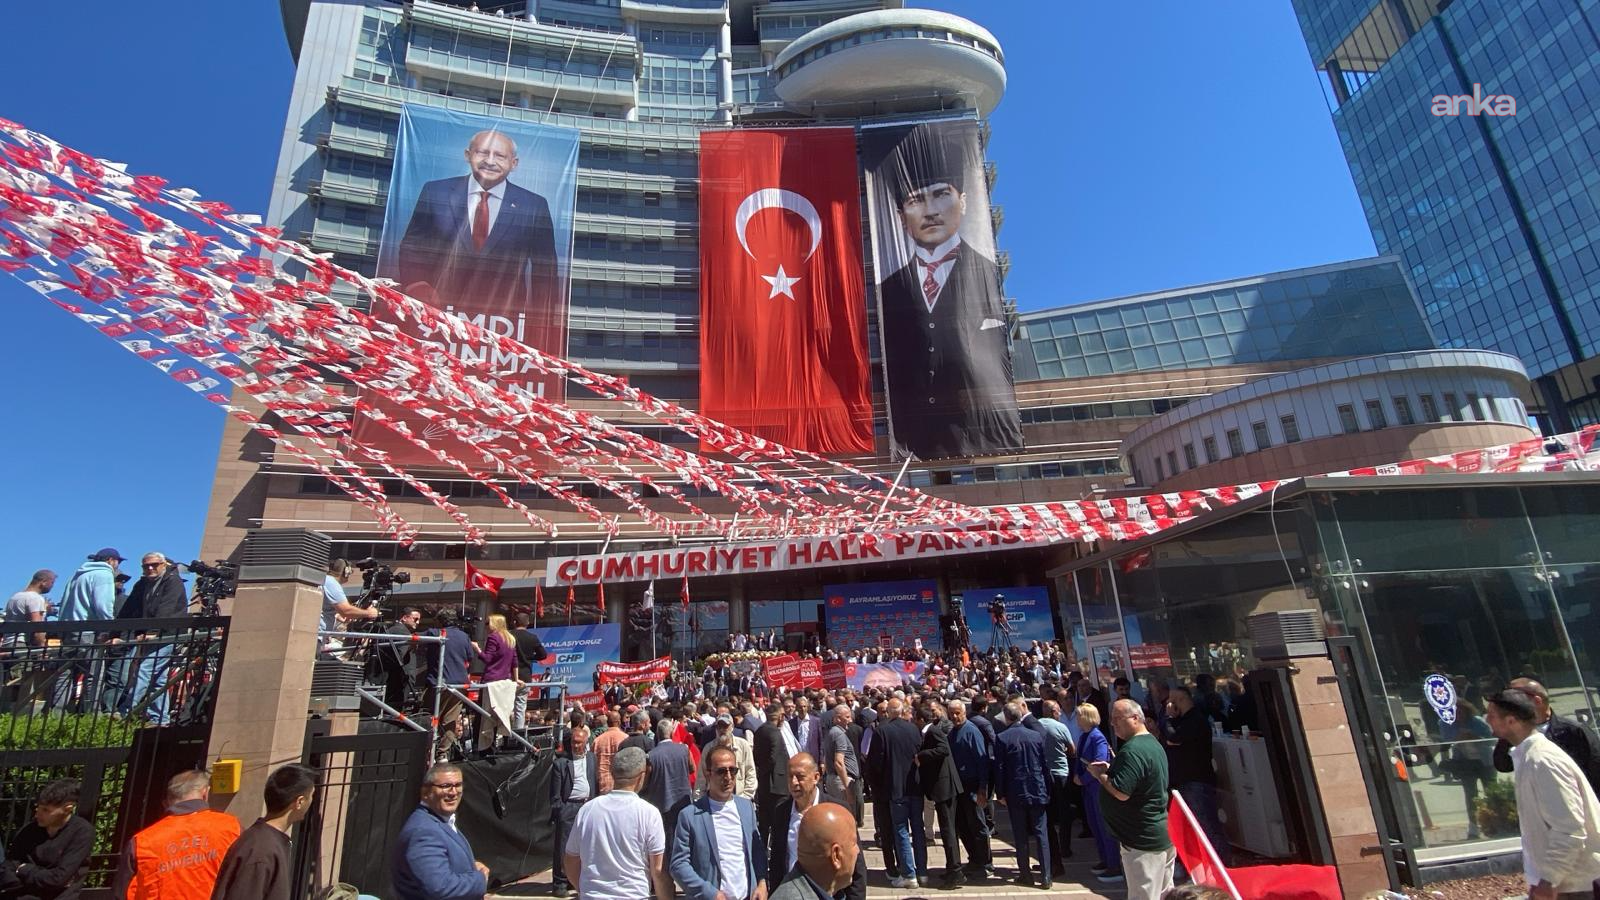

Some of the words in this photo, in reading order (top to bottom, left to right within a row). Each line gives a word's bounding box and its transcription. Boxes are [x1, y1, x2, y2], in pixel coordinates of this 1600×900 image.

[557, 545, 777, 582] CUMHURİYET
[788, 533, 883, 566] HALK
[1006, 613, 1025, 621] CHP
[557, 654, 583, 663] CHP
